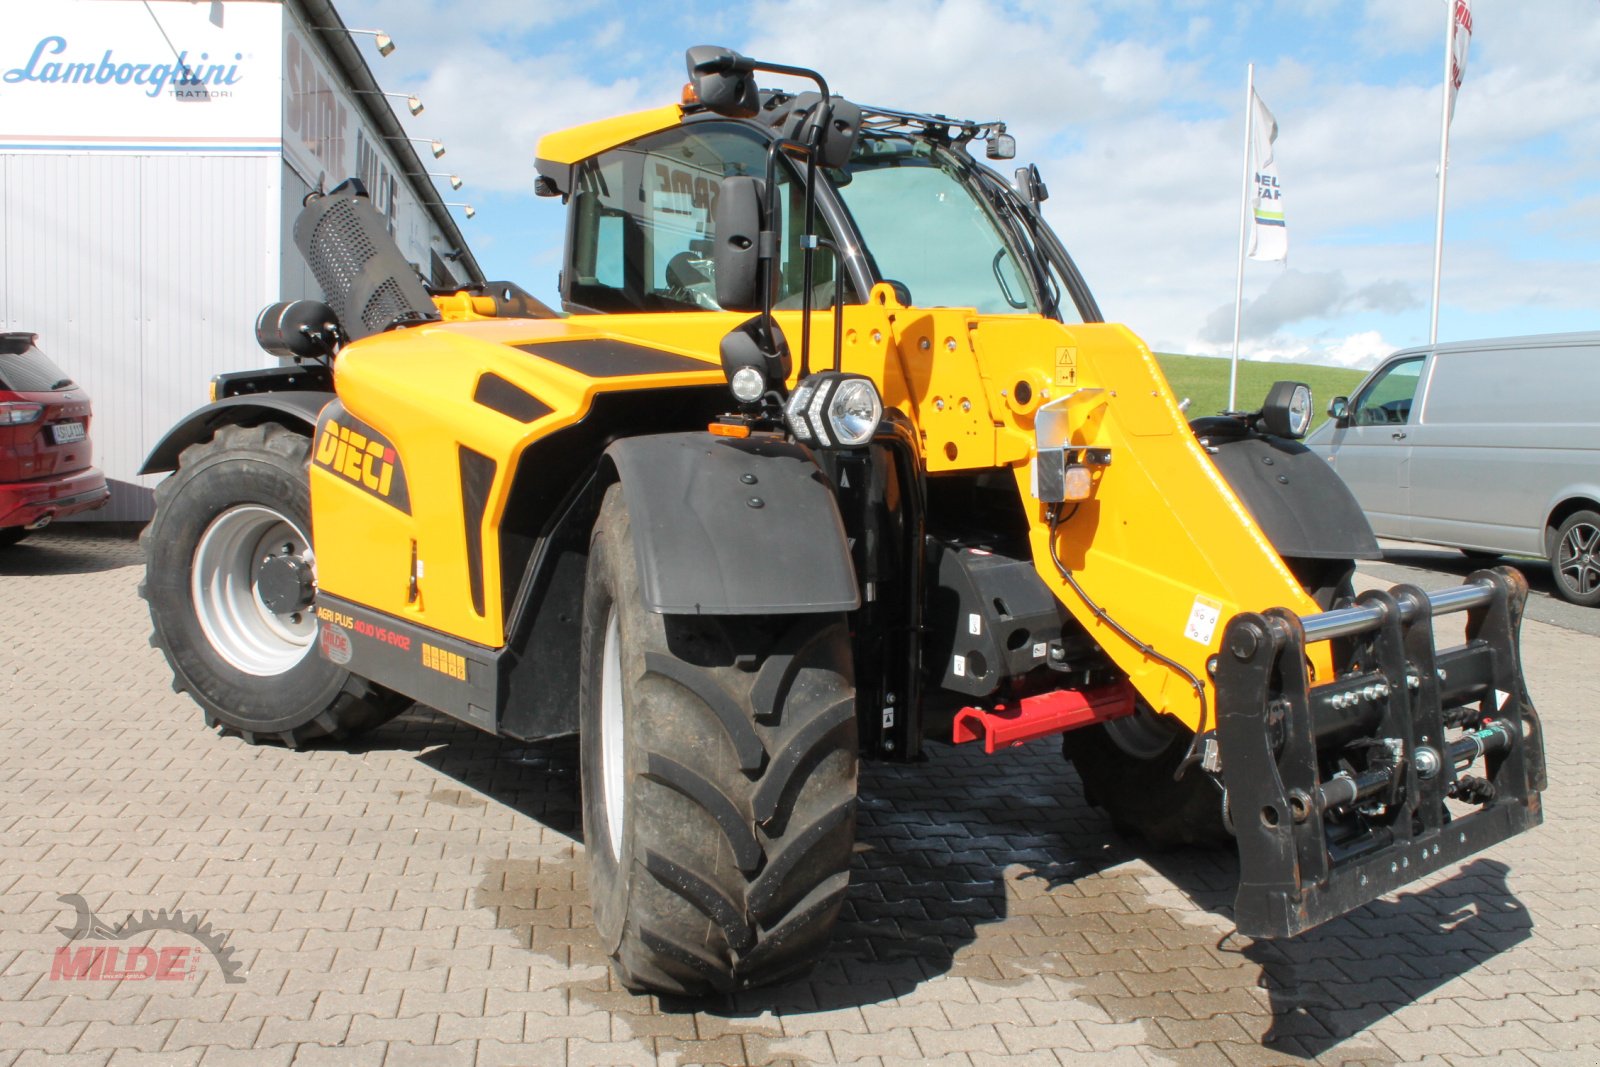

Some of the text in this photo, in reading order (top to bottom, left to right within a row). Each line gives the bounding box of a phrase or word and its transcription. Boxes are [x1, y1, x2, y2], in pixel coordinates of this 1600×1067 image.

[2, 35, 243, 98] Lamborghini
[168, 90, 233, 98] TRATTORI
[316, 419, 396, 497] DIECI
[317, 607, 333, 622] AGRI
[334, 612, 353, 629] PLUS
